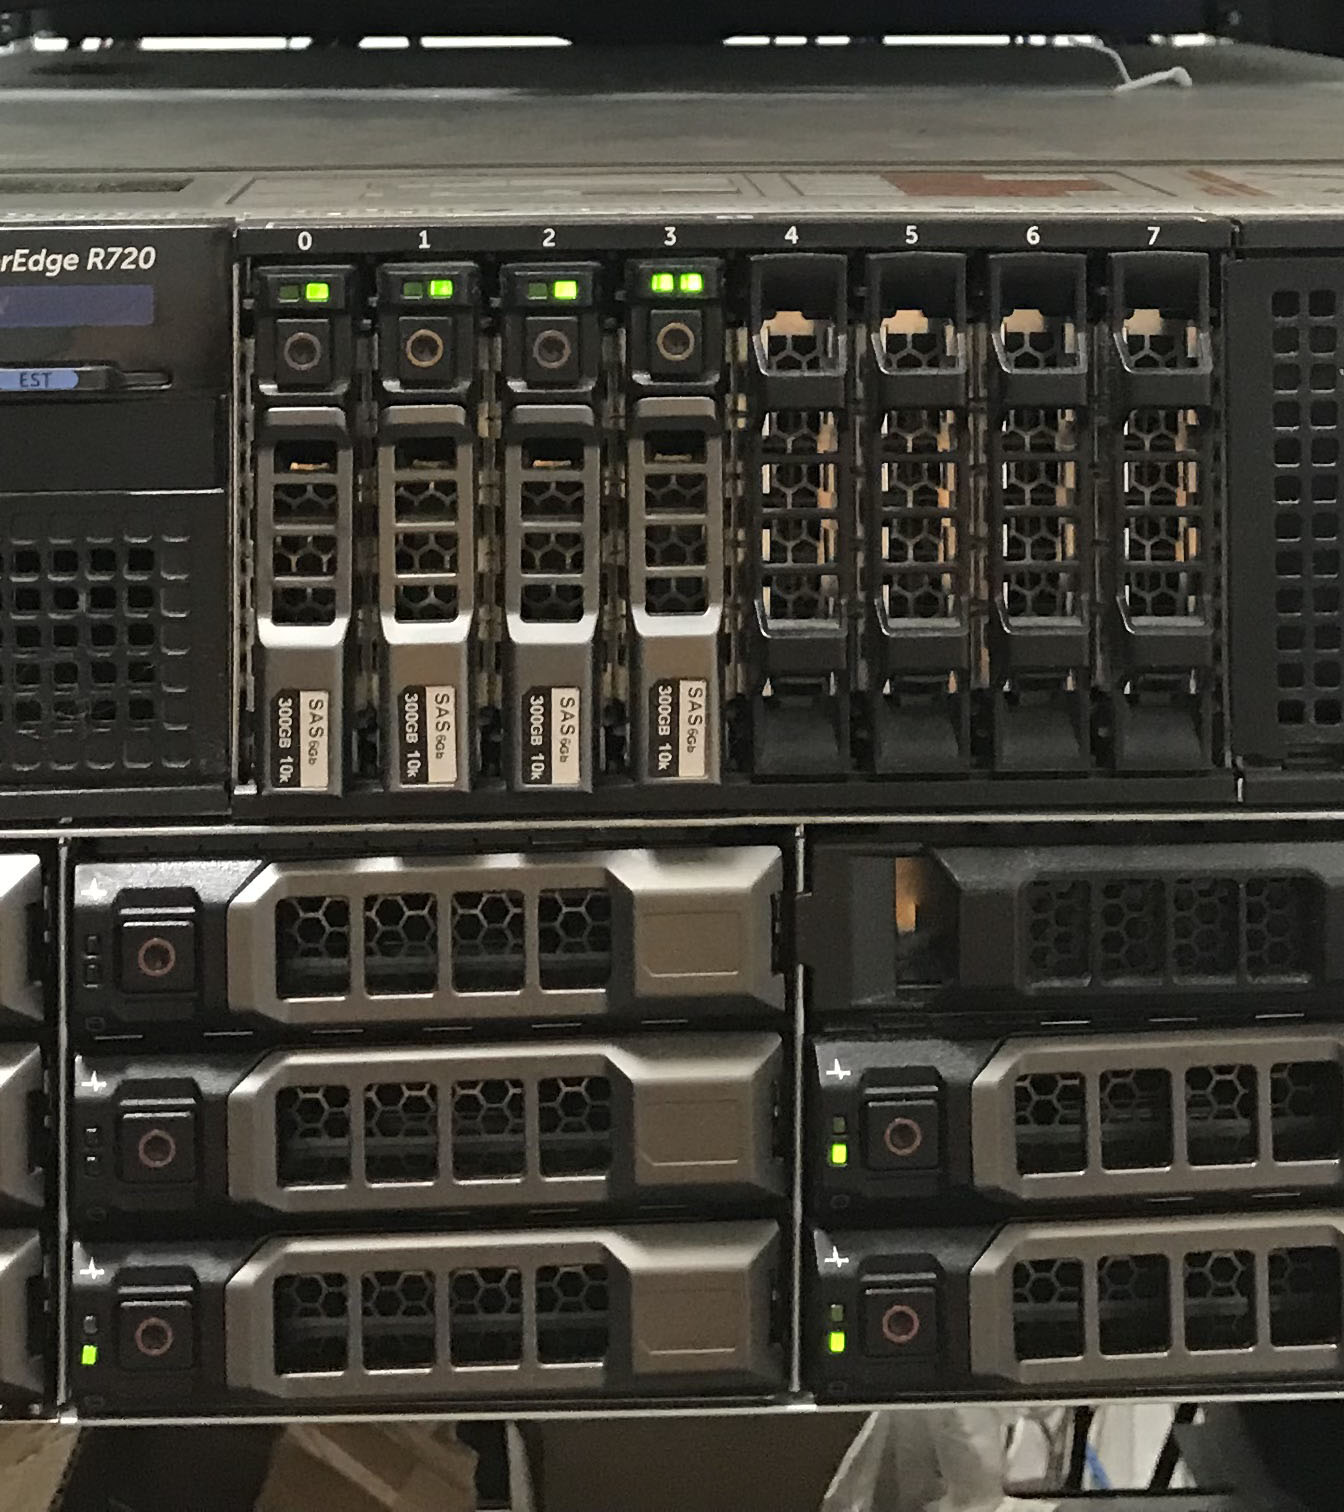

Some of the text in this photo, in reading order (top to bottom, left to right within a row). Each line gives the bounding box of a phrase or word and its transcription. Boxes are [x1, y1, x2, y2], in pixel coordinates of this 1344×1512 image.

[297, 231, 313, 251] 0
[418, 230, 431, 249] 1
[542, 228, 556, 248] 2
[663, 226, 677, 247] 3
[784, 226, 799, 244] 4
[905, 226, 919, 244] 5
[1026, 226, 1041, 244] 6
[1147, 226, 1161, 245] 7
[87, 246, 156, 271] R720
[19, 371, 53, 389] EST
[434, 693, 451, 732] SAS
[559, 697, 576, 736] SAS
[657, 685, 673, 736] 300GB
[687, 687, 704, 726] SAS
[278, 697, 294, 749] 300GB
[308, 699, 325, 739] SAS
[404, 693, 419, 744] 300GB
[529, 695, 545, 746] 300GB
